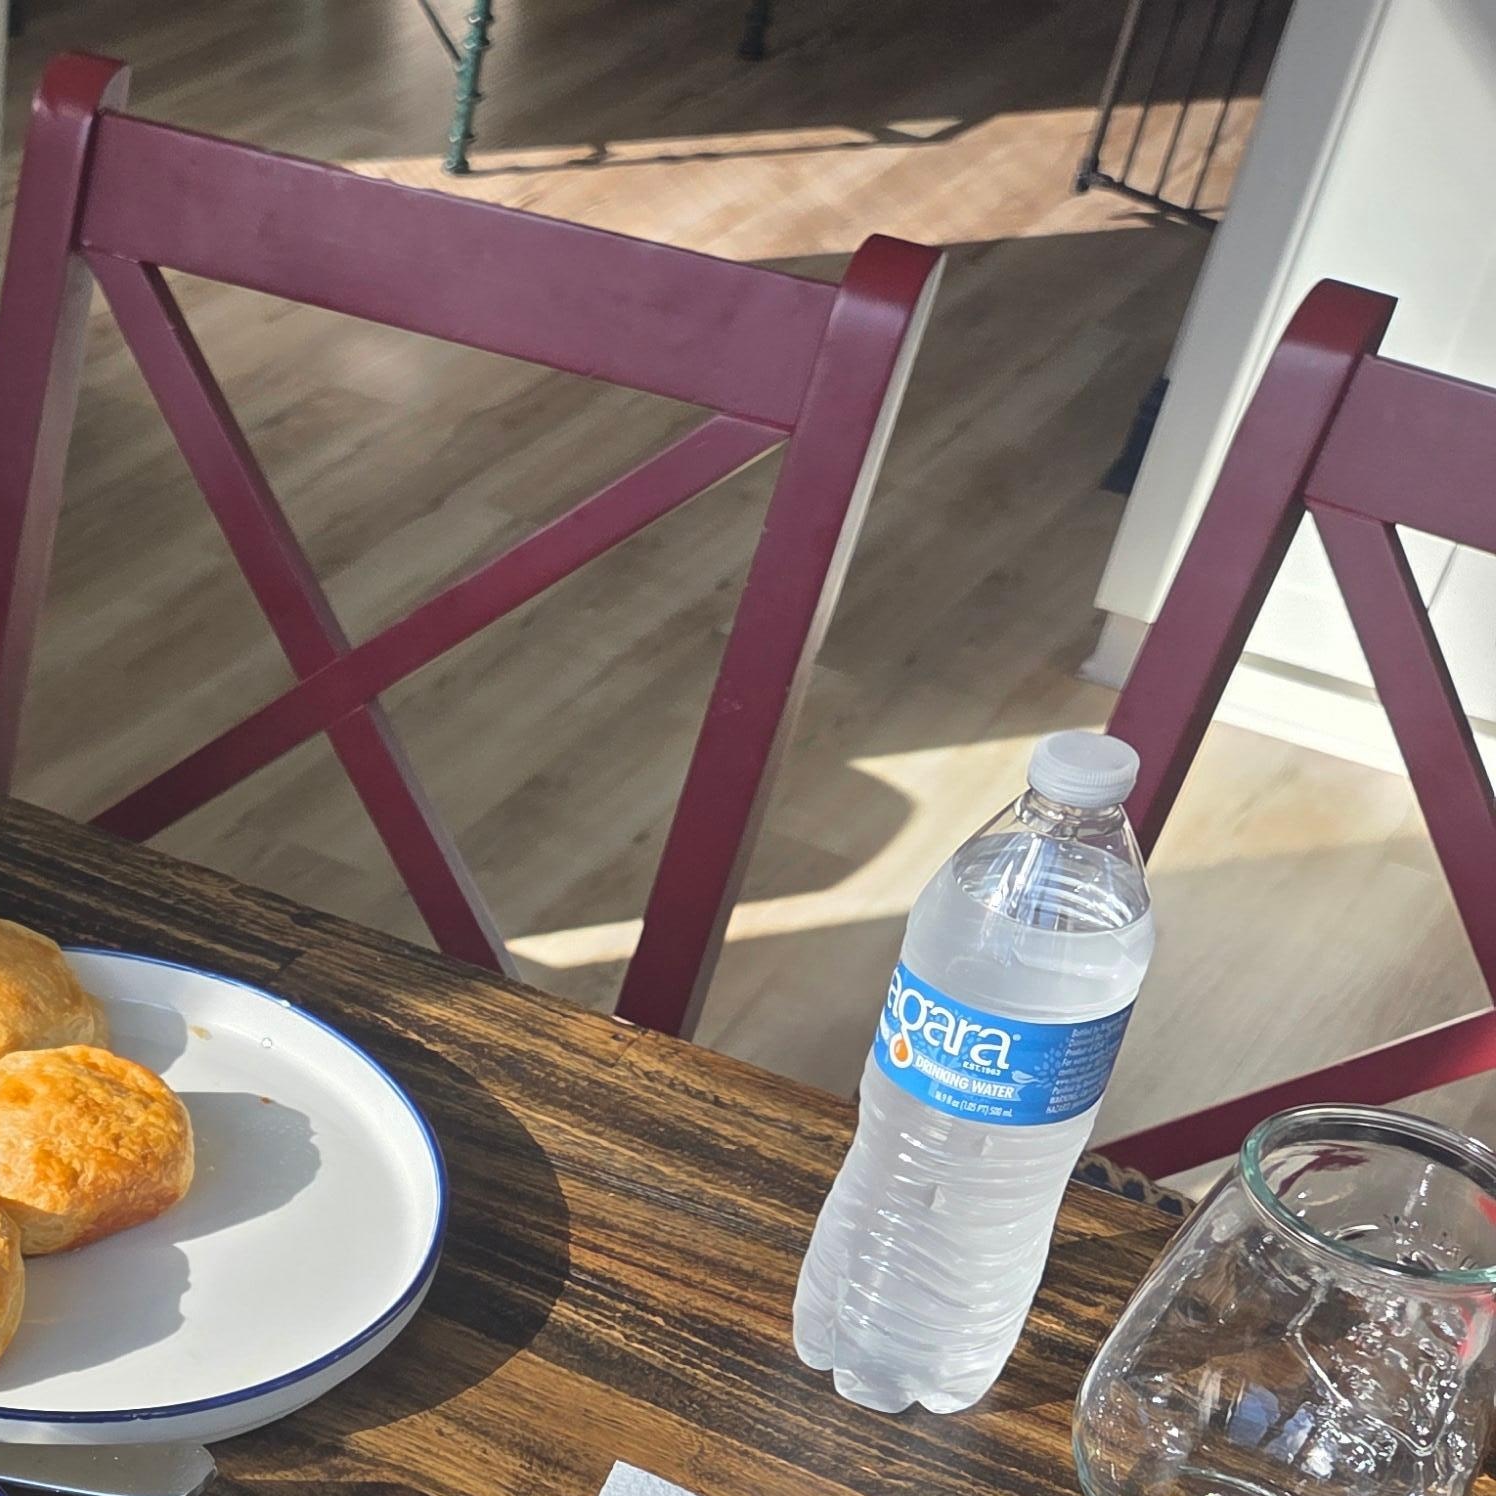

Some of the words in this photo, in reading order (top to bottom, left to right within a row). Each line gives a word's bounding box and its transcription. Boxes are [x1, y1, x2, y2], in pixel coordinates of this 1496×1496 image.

[888, 967, 1011, 1070] agara
[915, 1055, 969, 1090] DRINKING
[971, 1080, 1015, 1098] WATER
